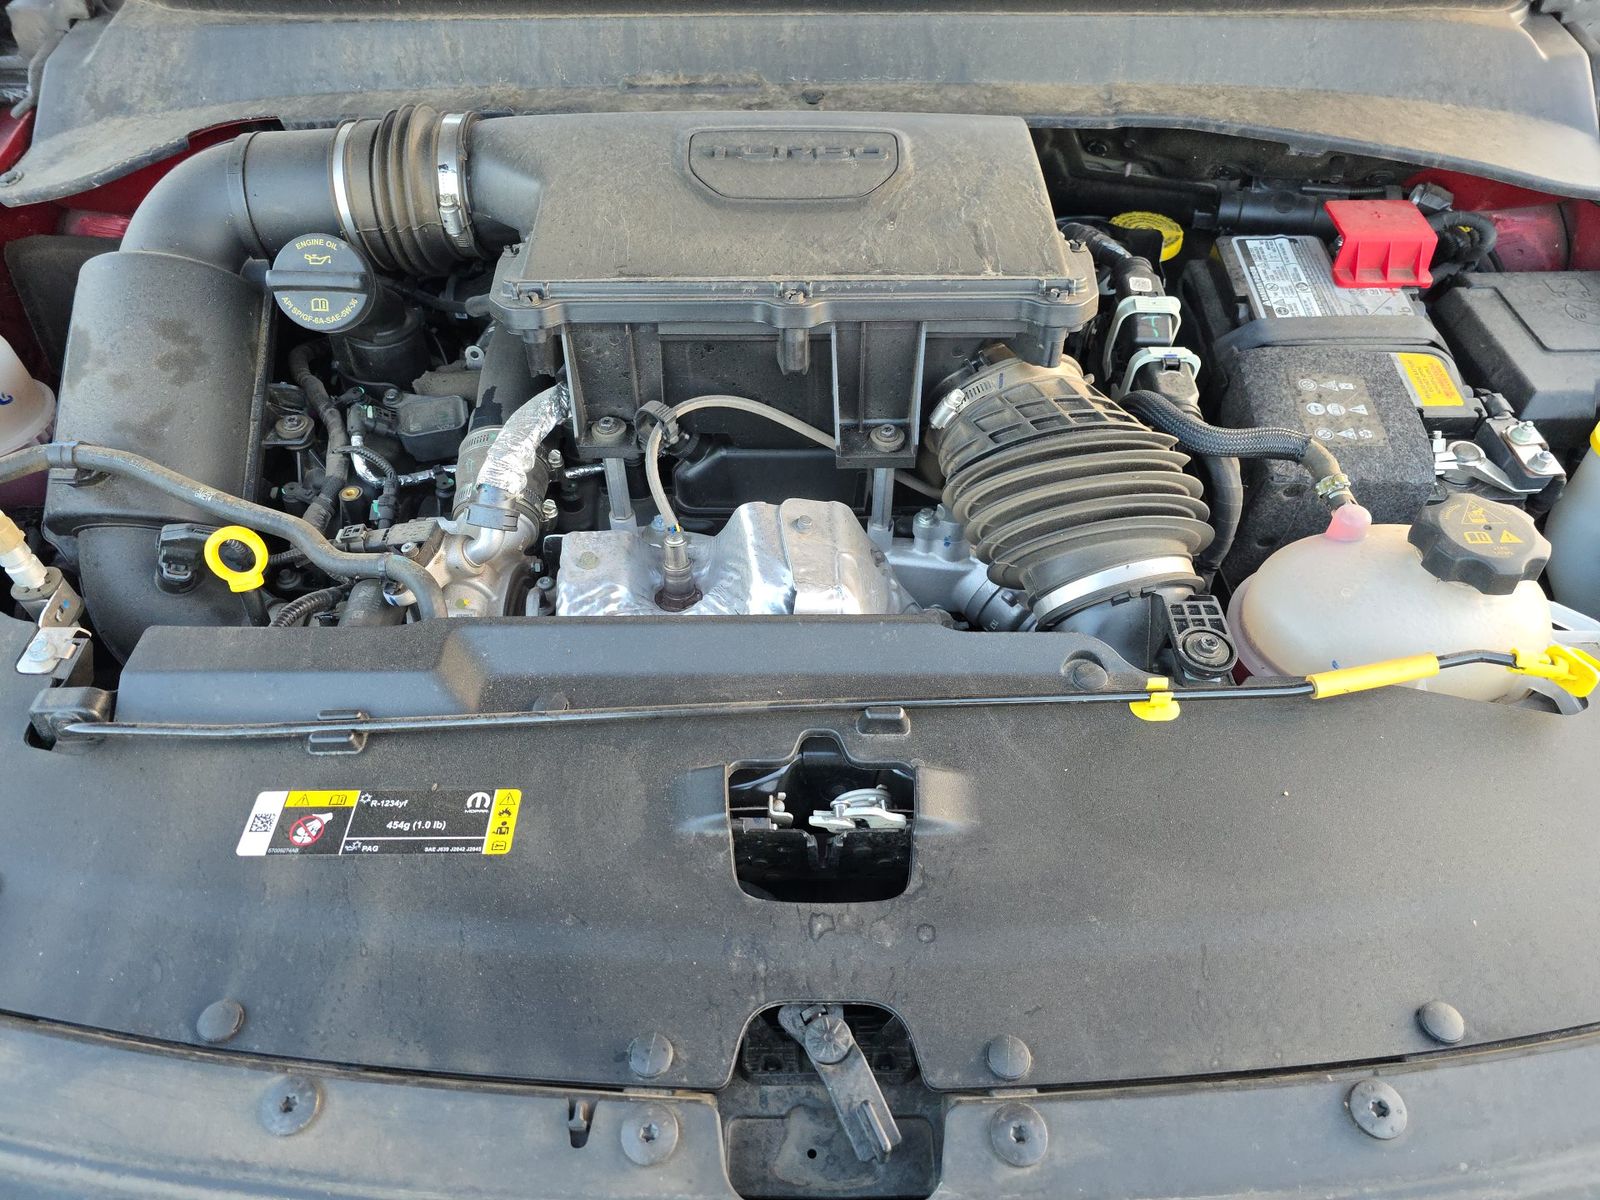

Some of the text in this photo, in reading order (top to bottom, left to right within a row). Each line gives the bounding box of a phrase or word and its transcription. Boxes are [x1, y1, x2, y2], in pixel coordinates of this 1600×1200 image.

[295, 238, 338, 251] ENGINE OIL
[281, 296, 294, 310] API
[370, 799, 409, 808] R-1234yf
[386, 820, 447, 831] 454g (1.0 lb)
